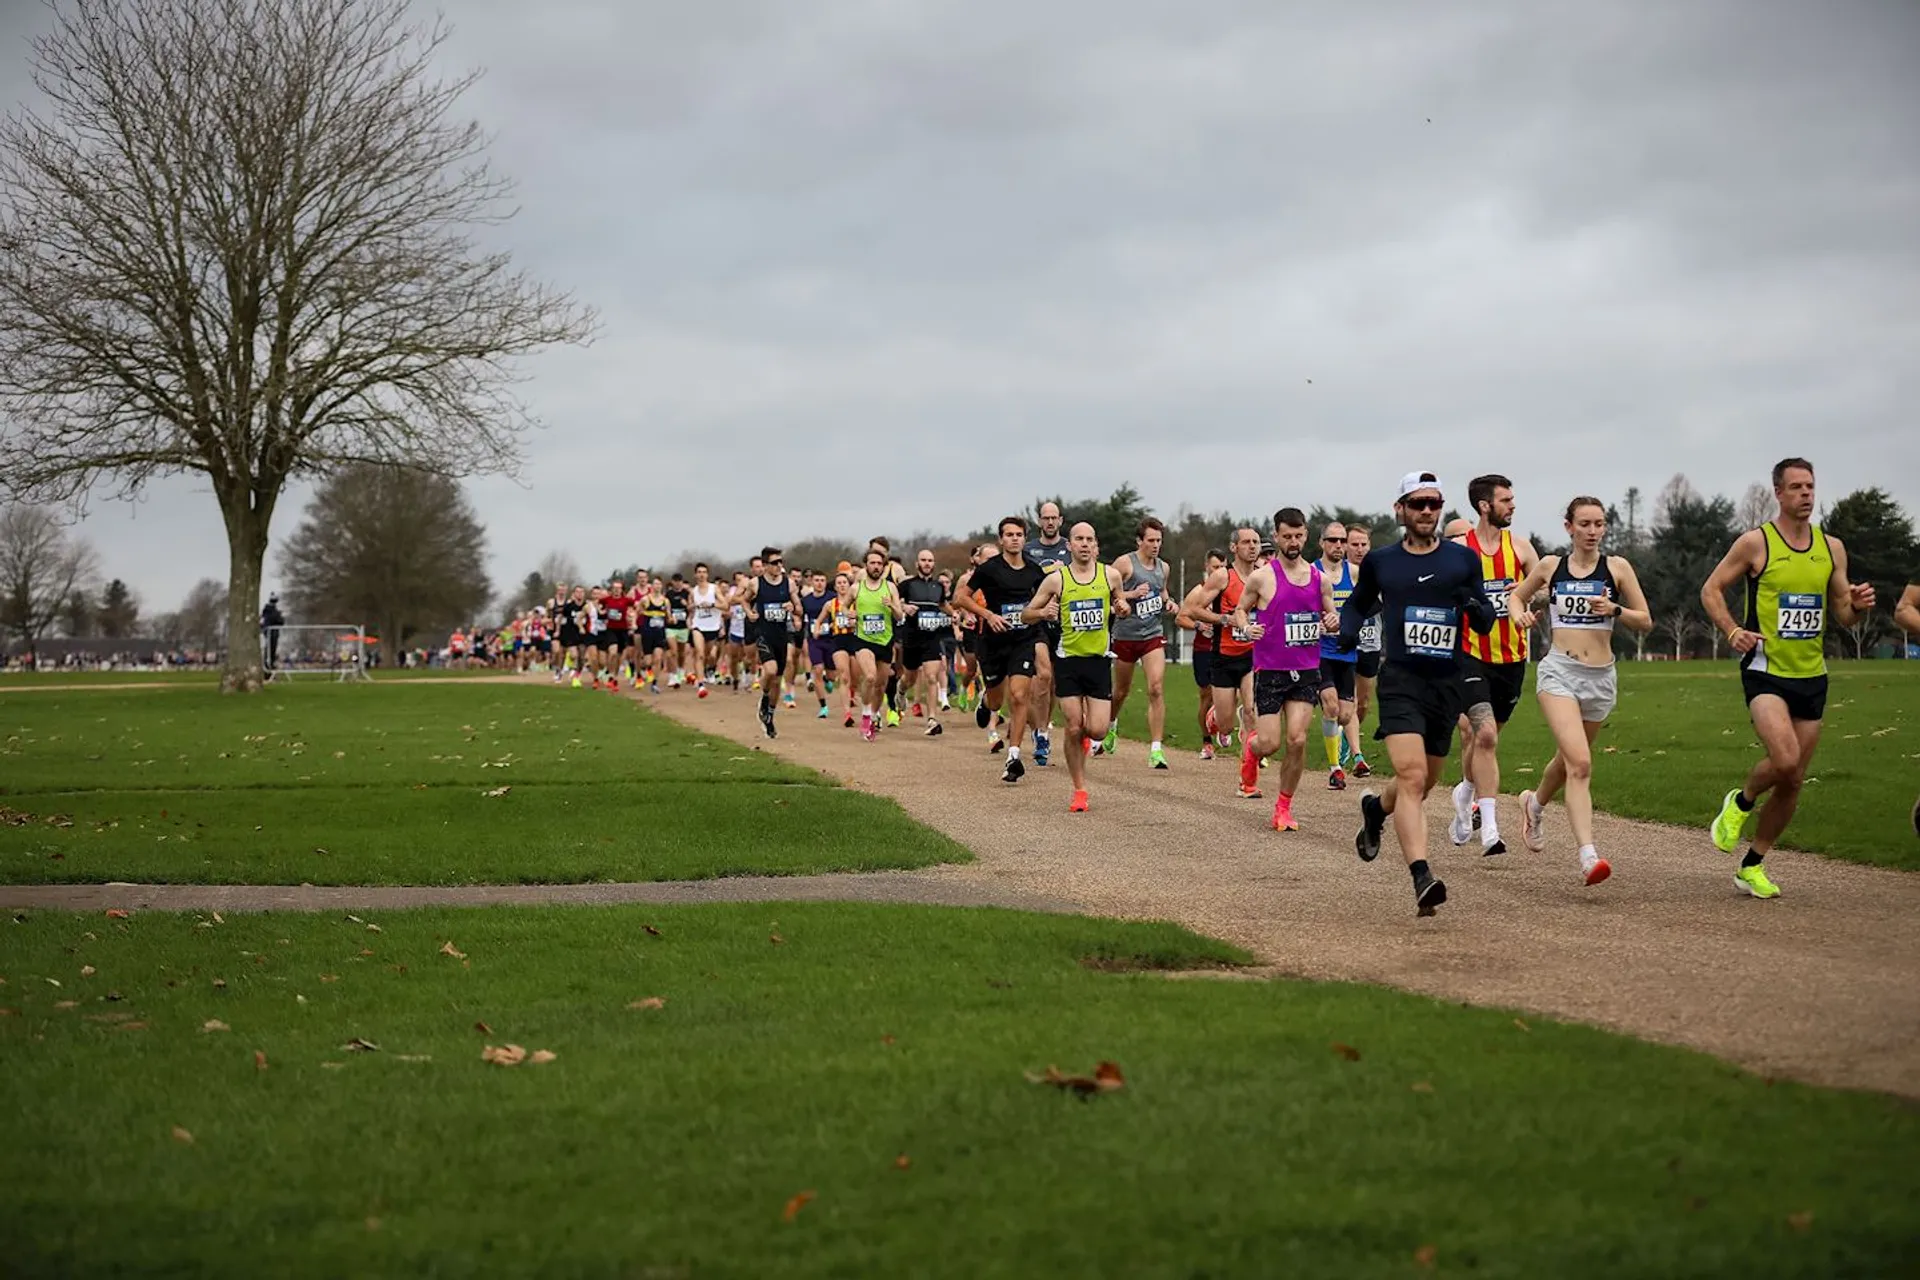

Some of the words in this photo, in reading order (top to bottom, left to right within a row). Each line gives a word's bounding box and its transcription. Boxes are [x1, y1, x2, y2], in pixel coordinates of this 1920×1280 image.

[1074, 610, 1102, 626] 4003
[1782, 610, 1820, 630] 2495
[1289, 623, 1318, 640] 1182
[1408, 623, 1452, 647] 4604
